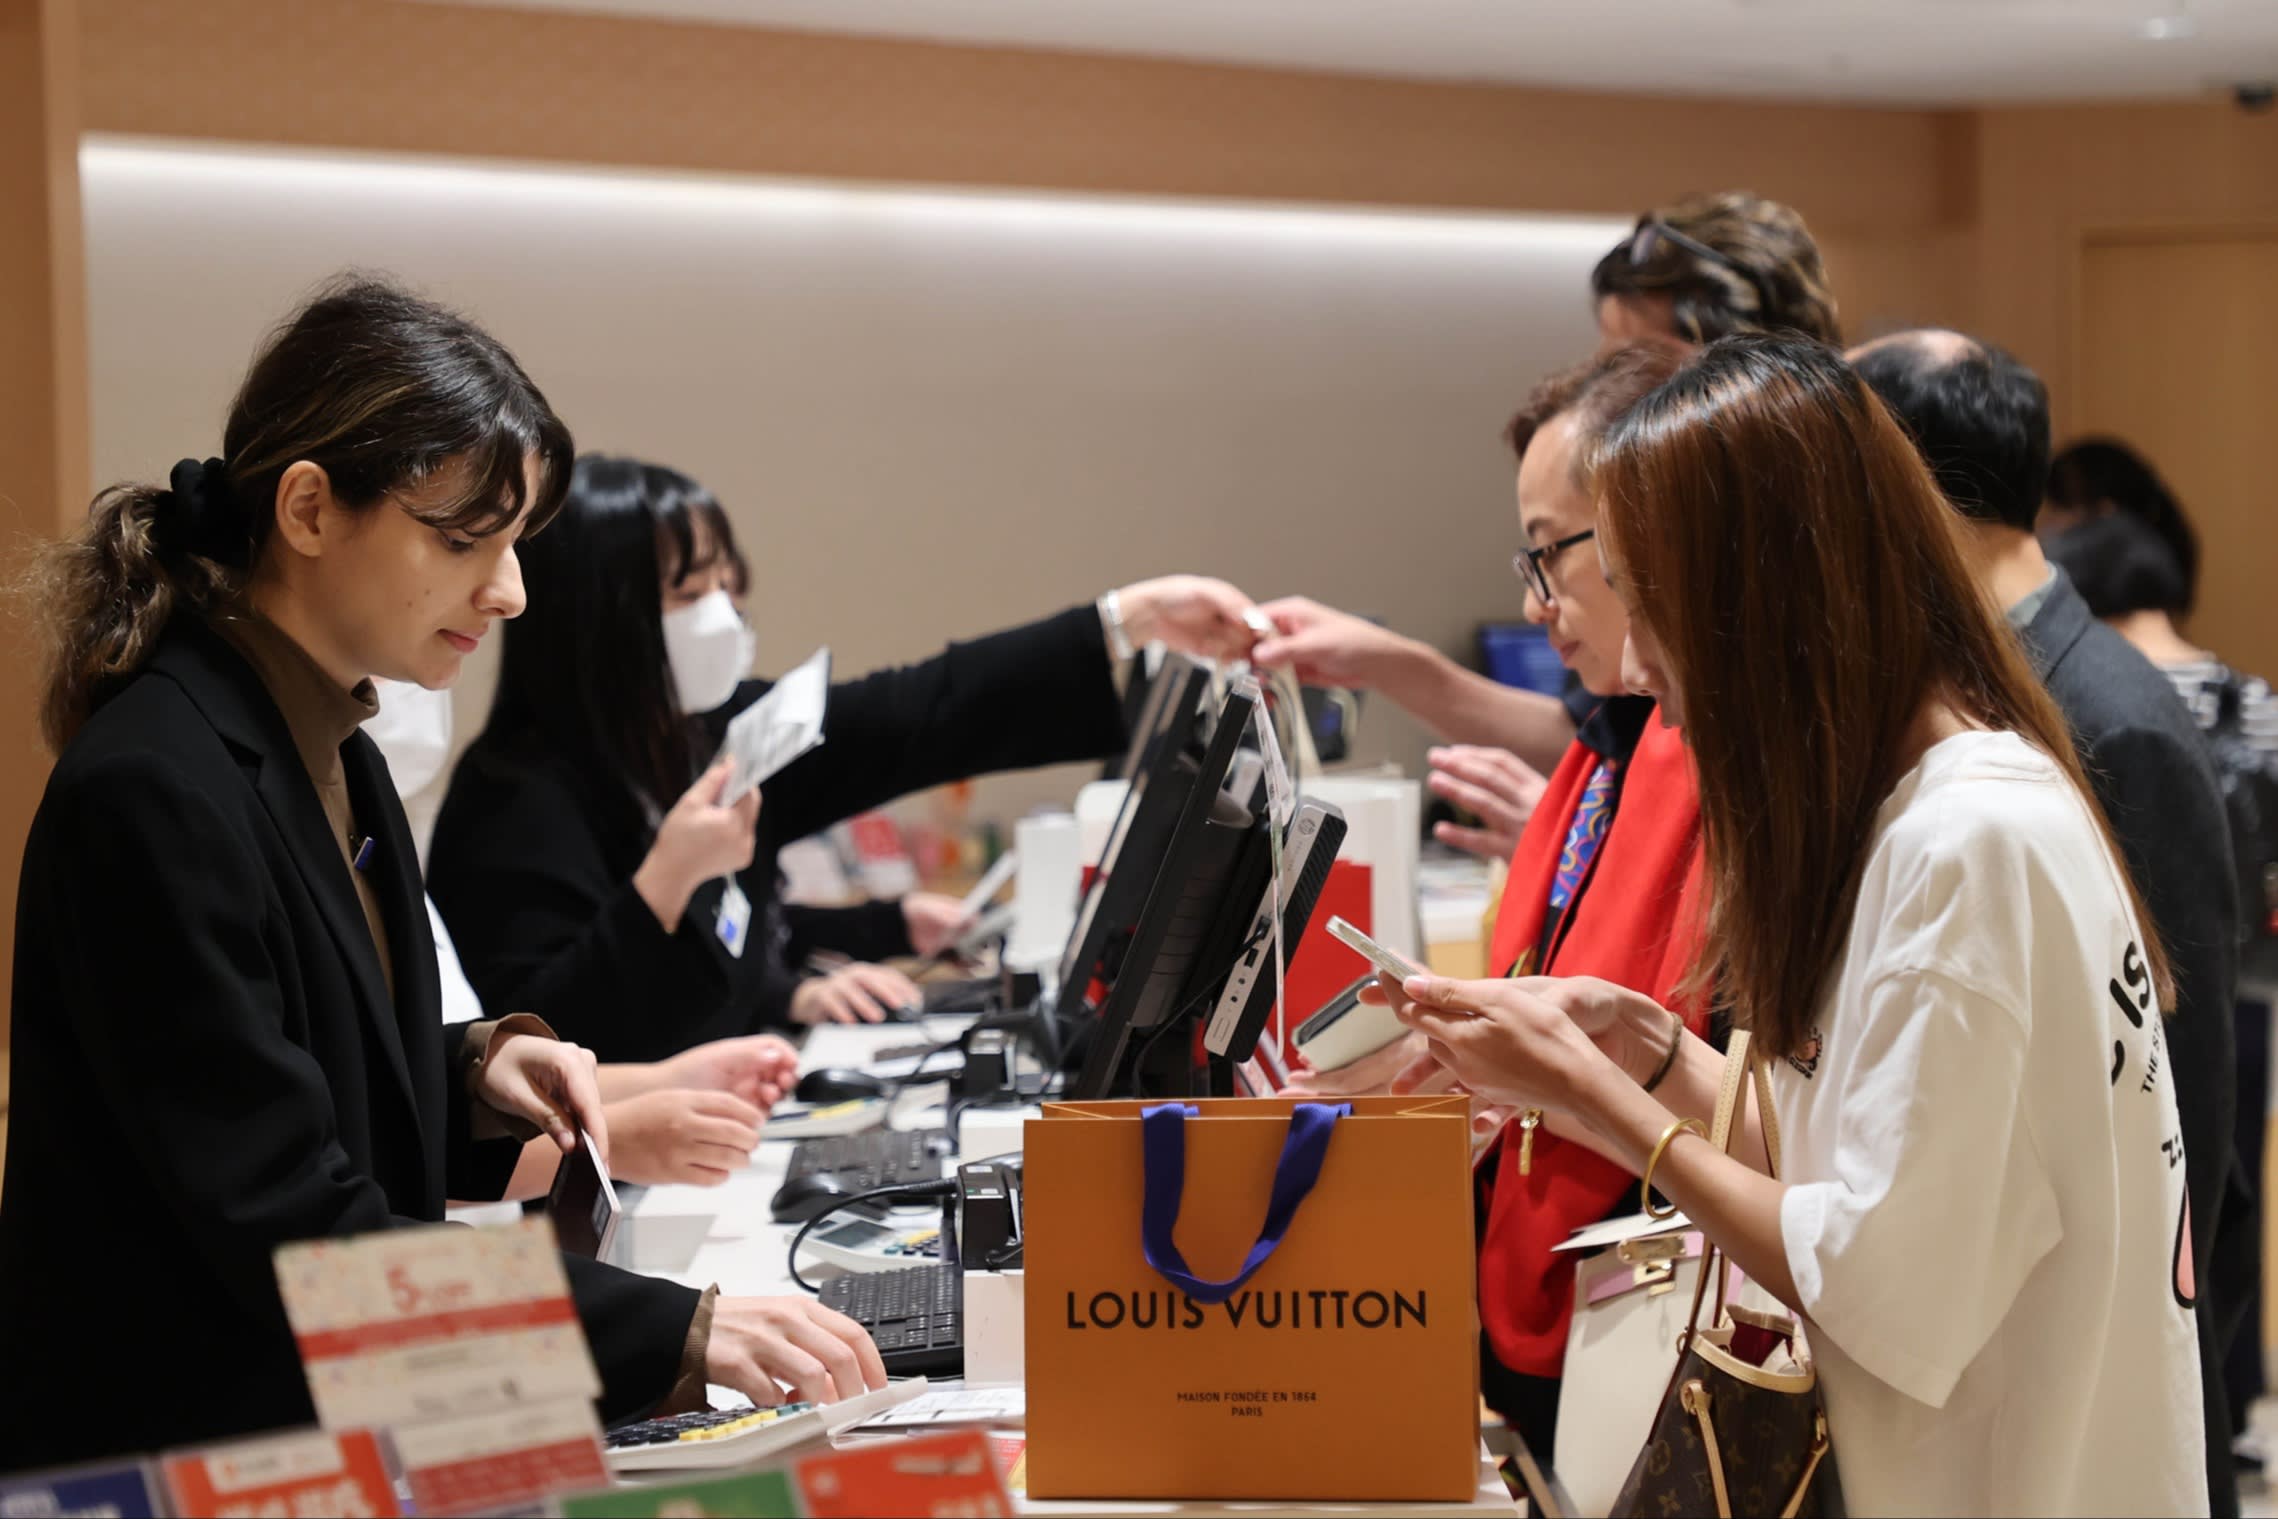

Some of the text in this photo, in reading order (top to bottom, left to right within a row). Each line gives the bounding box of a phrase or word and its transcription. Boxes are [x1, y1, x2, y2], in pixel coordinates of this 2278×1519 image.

[1067, 1290, 1427, 1329] LOUIS VUITTON
[1176, 1391, 1220, 1403] MAISON
[1224, 1388, 1268, 1403] FONDÉE
[1272, 1391, 1288, 1402] EN
[1231, 1406, 1263, 1417] PARIS
